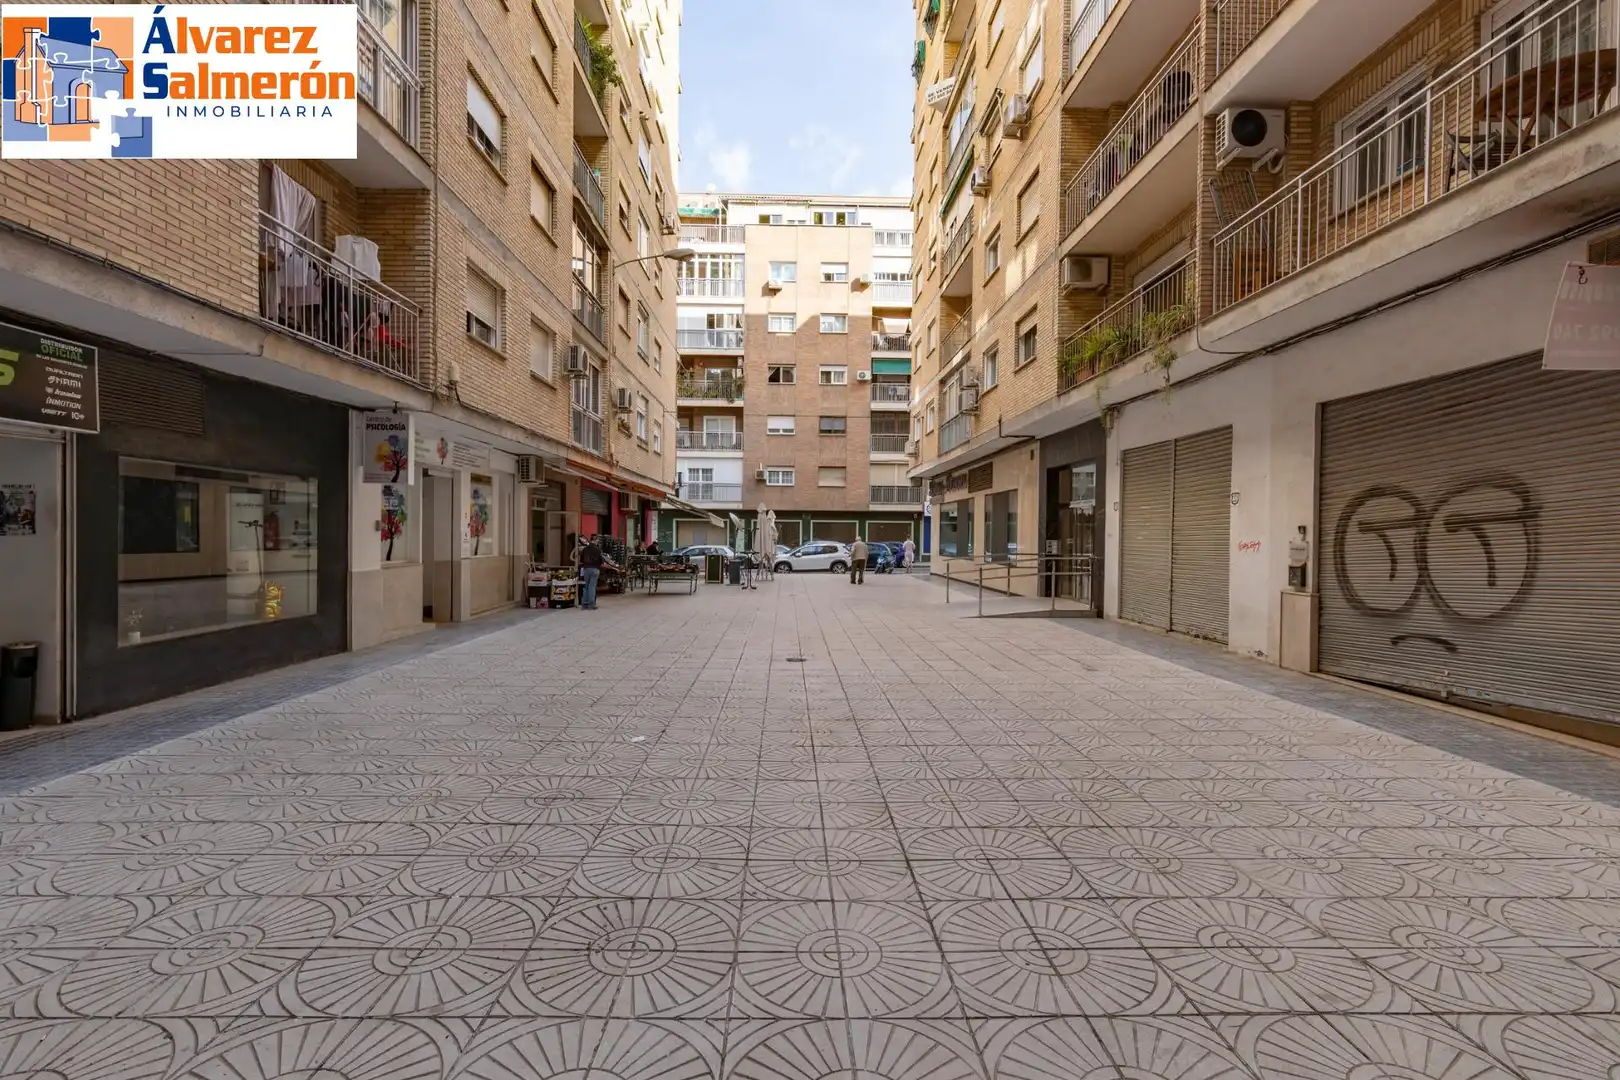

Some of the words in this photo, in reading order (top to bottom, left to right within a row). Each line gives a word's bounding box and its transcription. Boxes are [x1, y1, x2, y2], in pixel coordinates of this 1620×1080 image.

[40, 338, 82, 353] DISTRIBUIDOR
[41, 344, 83, 361] OFICIAL
[366, 421, 405, 430] PSICOLOGÍA
